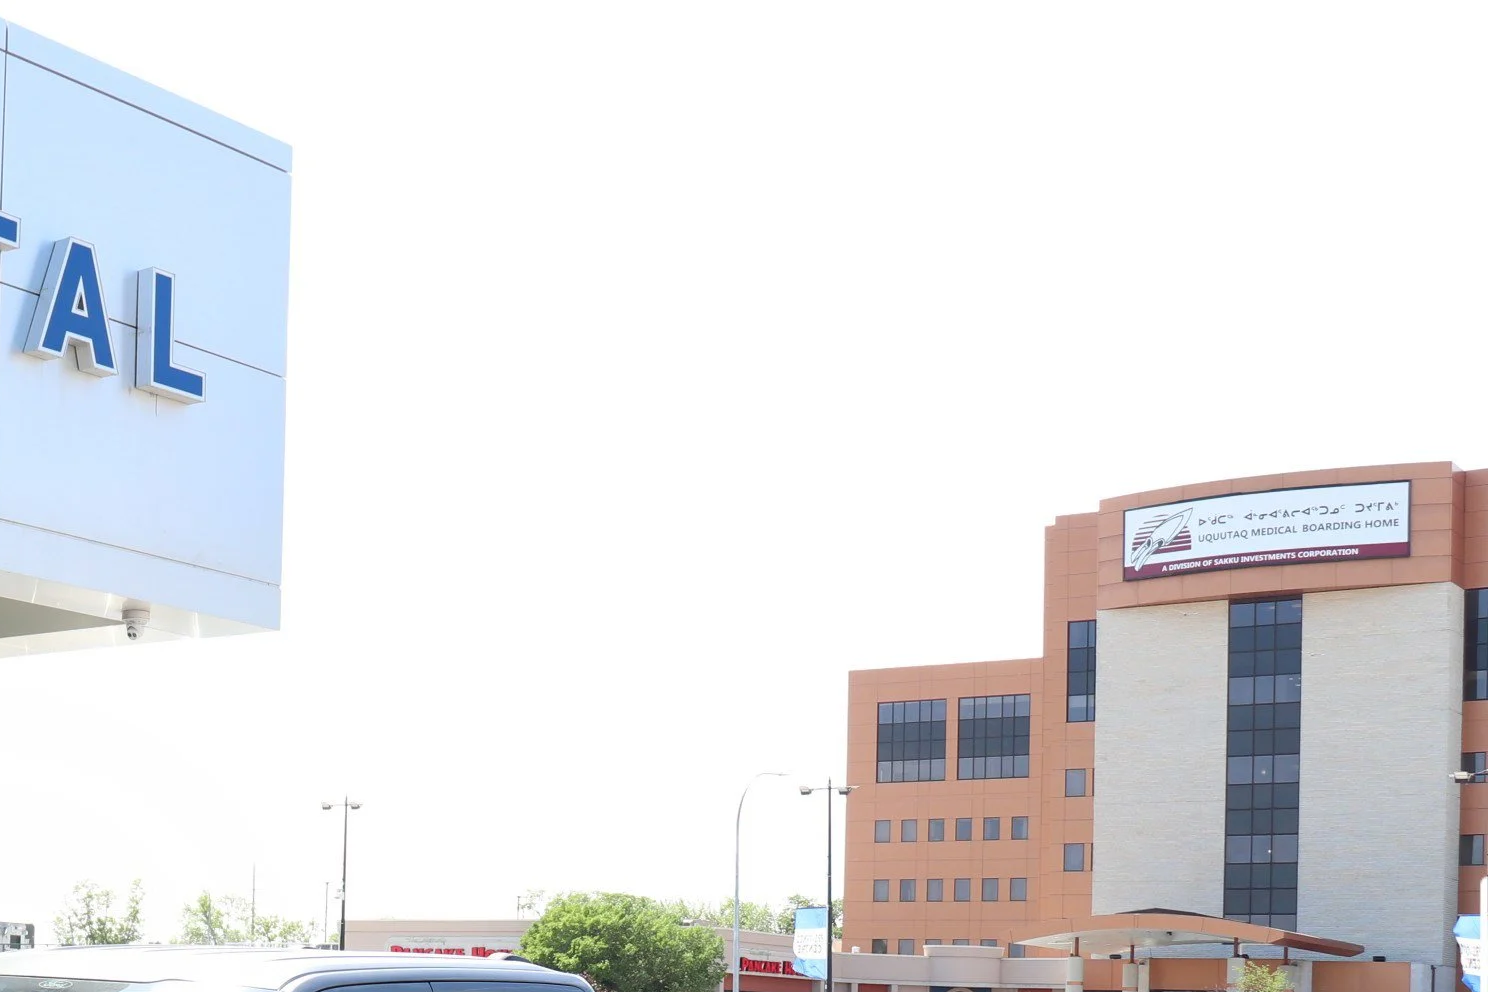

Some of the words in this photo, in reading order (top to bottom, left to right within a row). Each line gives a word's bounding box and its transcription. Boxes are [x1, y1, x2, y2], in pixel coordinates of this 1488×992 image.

[1198, 530, 1248, 543] UQUUTAQ
[1251, 526, 1298, 537] MEDICAL
[1302, 521, 1361, 533] BOARDING
[1365, 518, 1399, 529] HOME
[1169, 561, 1201, 571] DIVISION
[1214, 556, 1240, 566] SAKKU
[1240, 552, 1296, 563] INVESTMENTS
[1297, 548, 1359, 558] CORPORATION
[740, 957, 782, 974] PANCAKE
